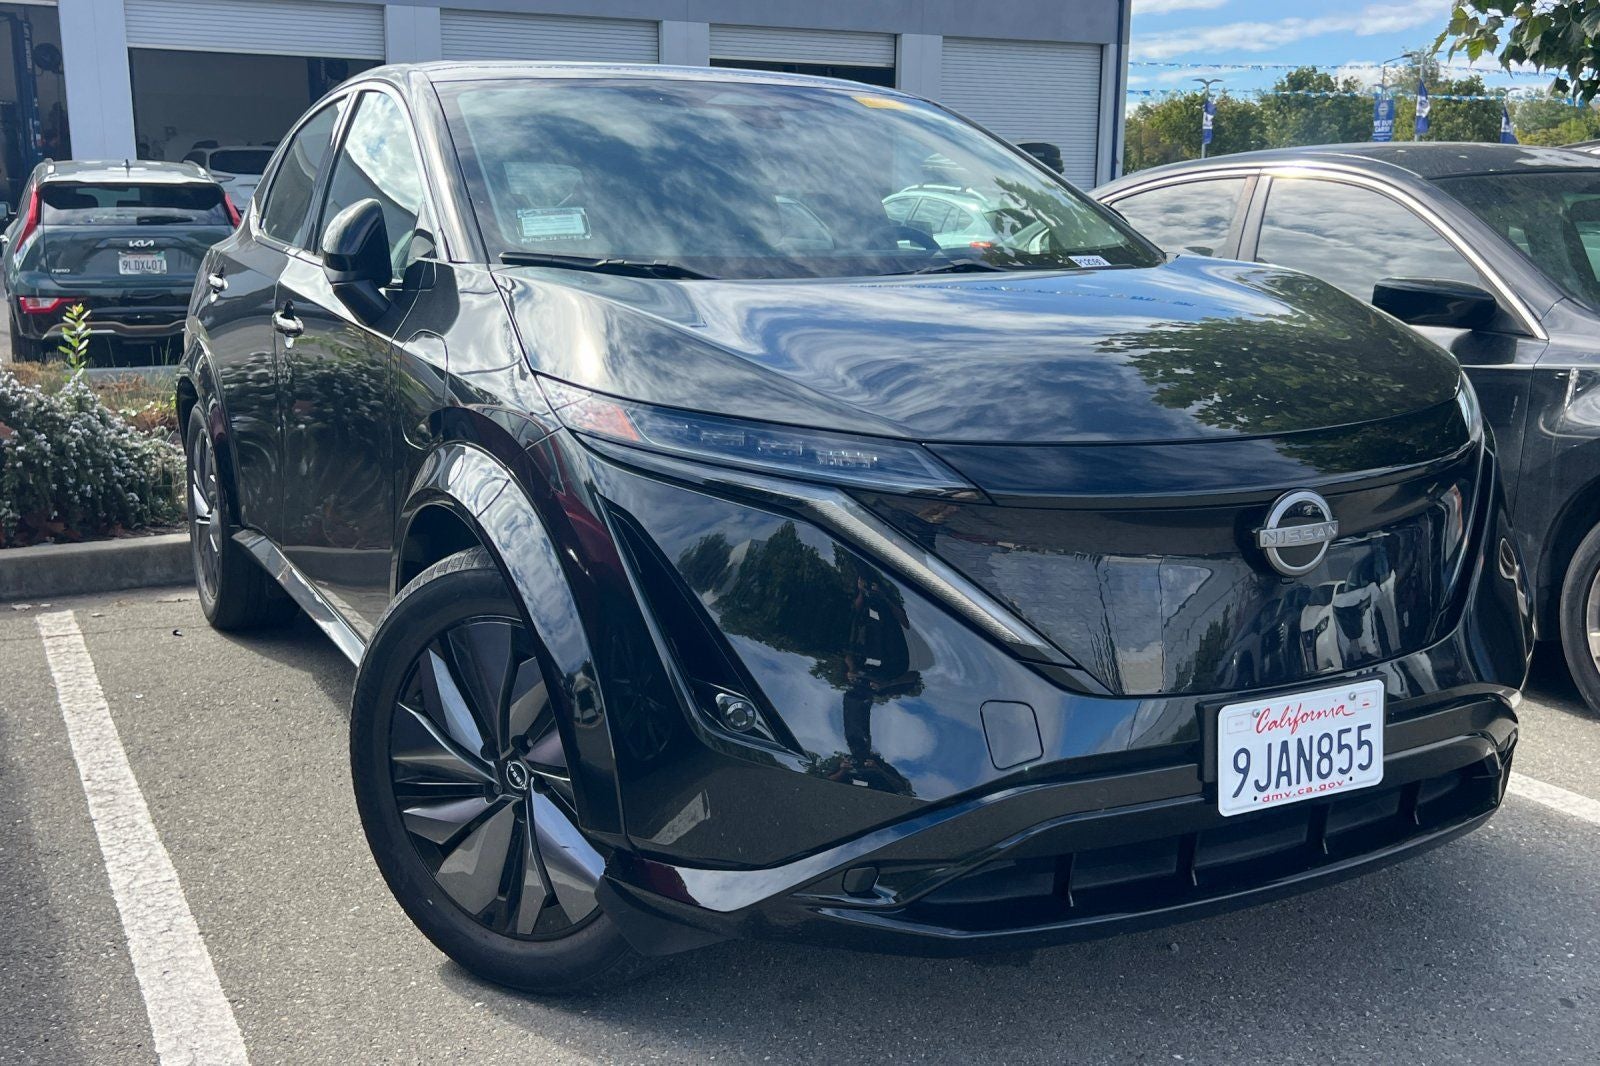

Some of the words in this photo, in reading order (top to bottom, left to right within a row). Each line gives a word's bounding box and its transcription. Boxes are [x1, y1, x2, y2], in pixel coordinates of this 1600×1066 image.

[1263, 523, 1337, 545] NISSAN
[1256, 703, 1355, 735] California
[1232, 723, 1373, 799] 9JAN855
[1262, 780, 1344, 803] dmv.ca.gov
